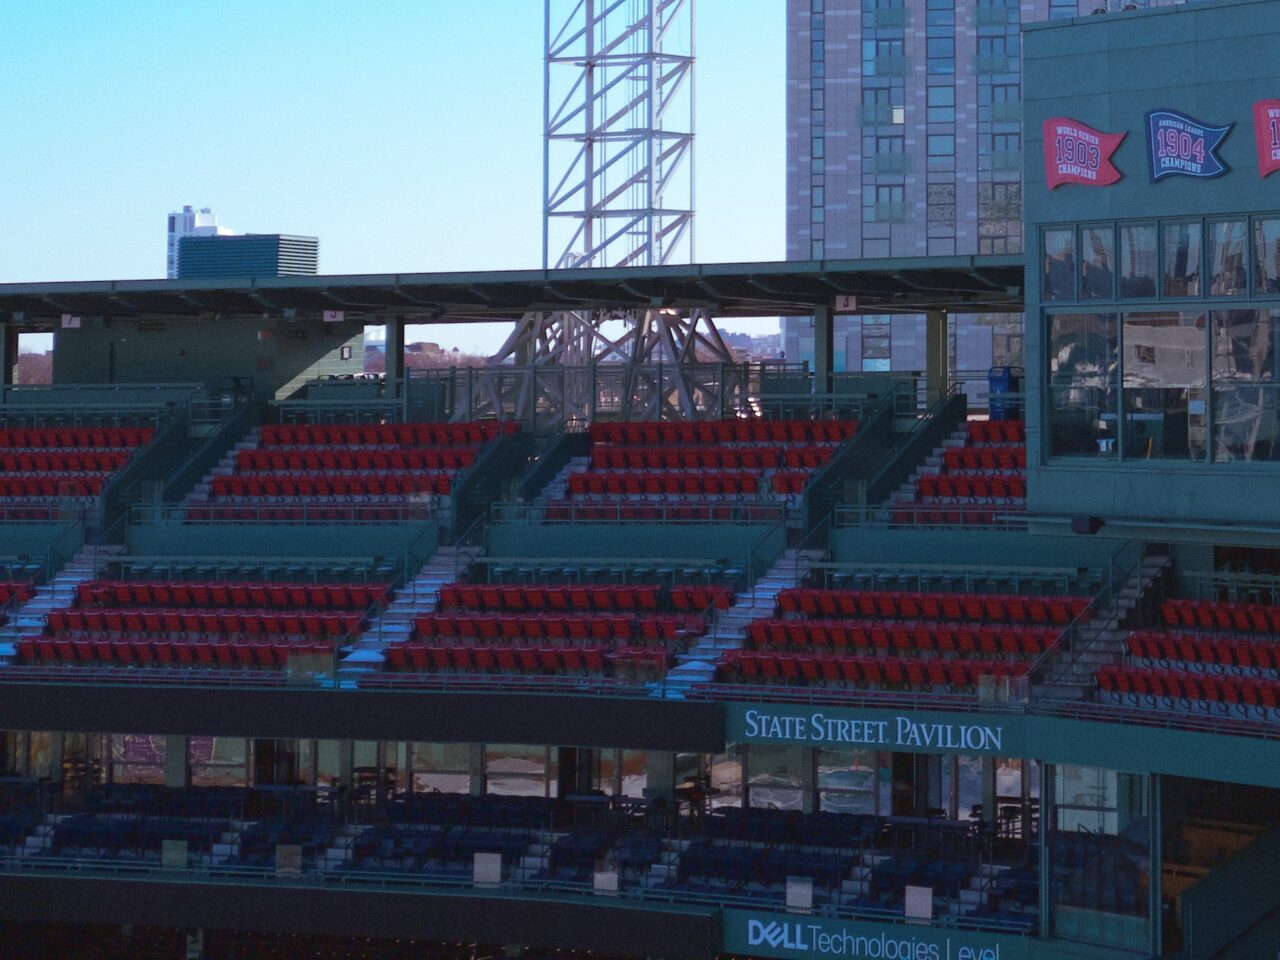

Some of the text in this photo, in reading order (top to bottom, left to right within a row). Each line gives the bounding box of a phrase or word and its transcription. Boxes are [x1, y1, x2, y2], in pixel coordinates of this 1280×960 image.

[1056, 126, 1099, 145] WORLD SERIES
[1158, 128, 1205, 164] 1904
[1056, 136, 1101, 171] 1903
[1161, 156, 1202, 174] CHAMPIONS
[1058, 163, 1097, 180] CHAMPIONS
[745, 710, 1003, 751] STATE STREET PAVILION
[748, 919, 808, 951] DELL
[808, 925, 940, 960] Technologies
